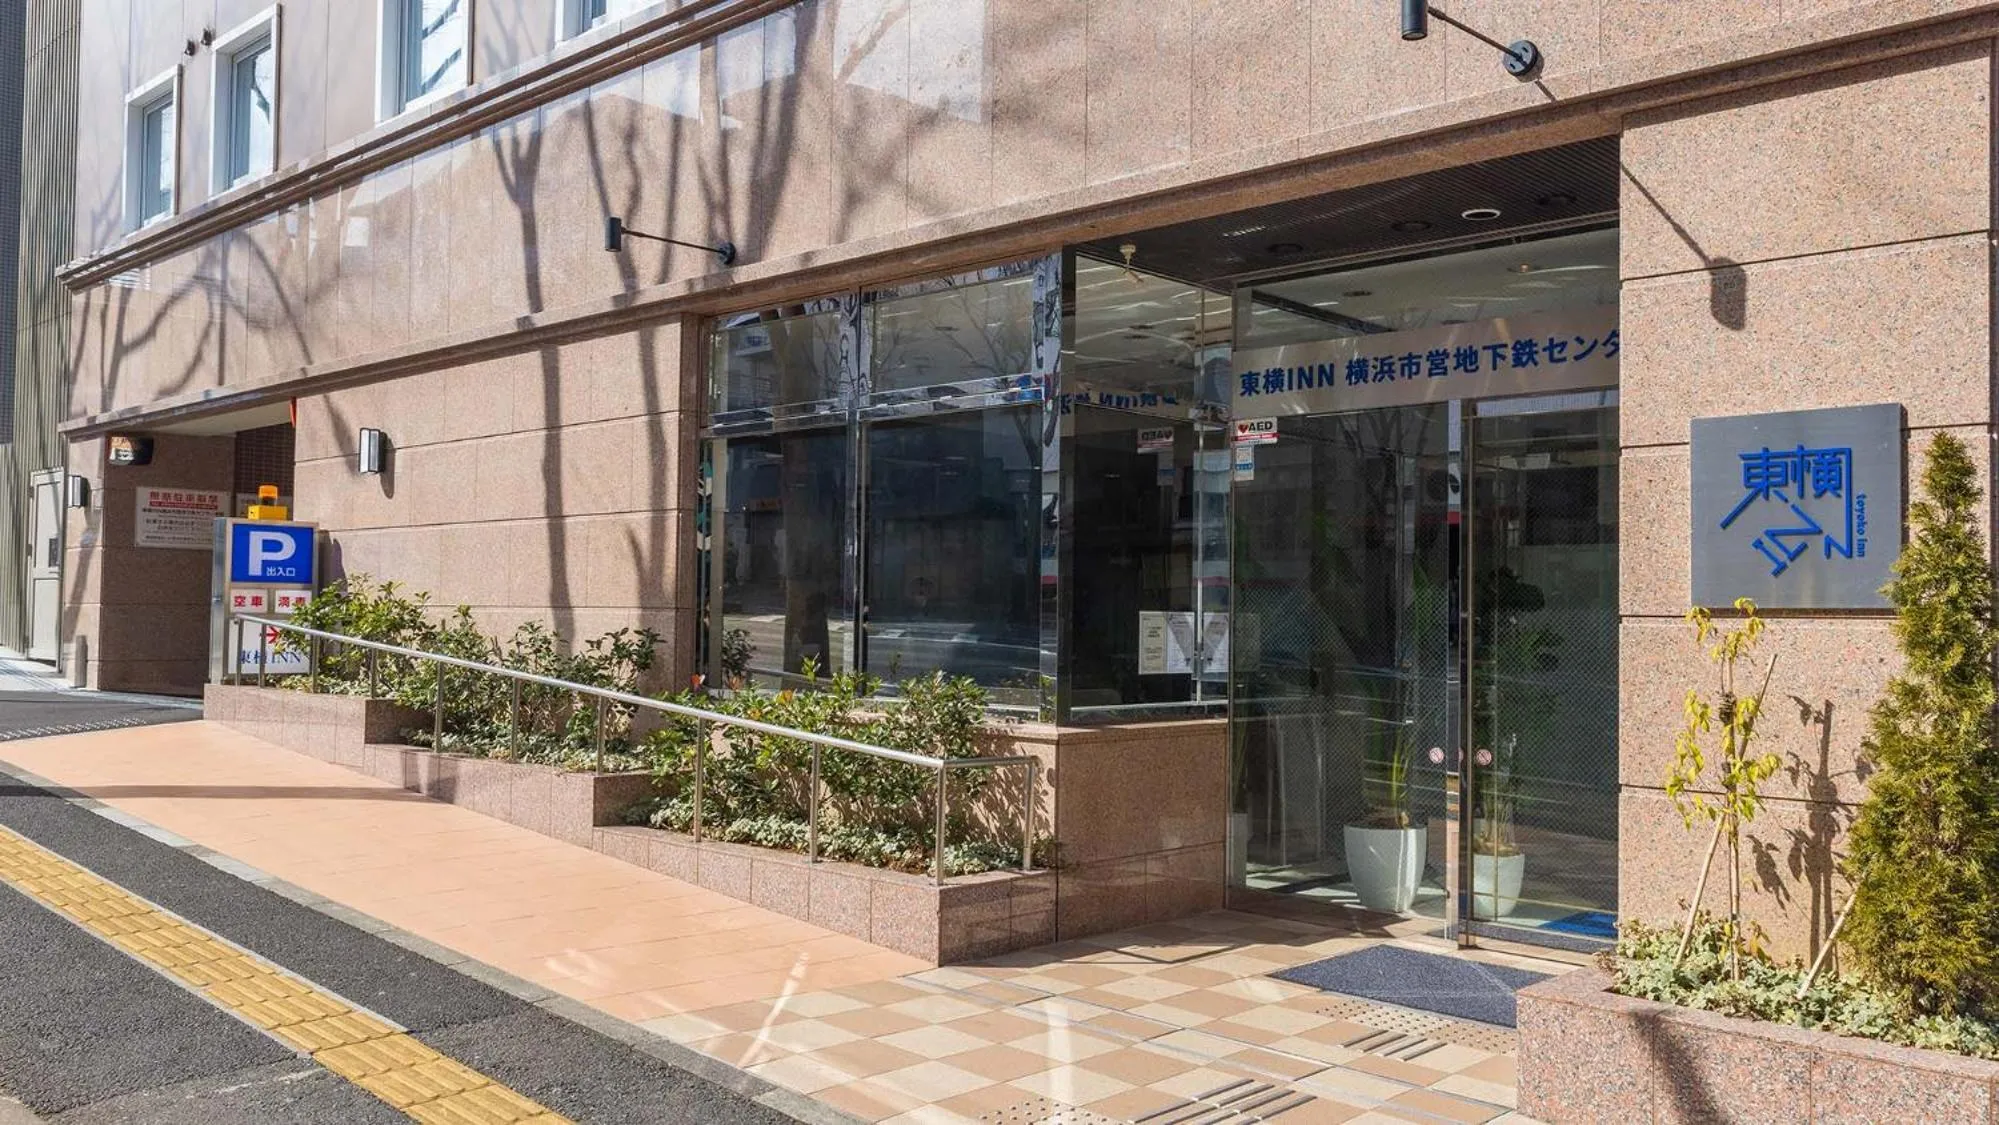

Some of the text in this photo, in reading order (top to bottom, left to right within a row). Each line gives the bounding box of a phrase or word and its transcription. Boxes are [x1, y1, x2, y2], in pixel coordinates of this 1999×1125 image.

[1240, 363, 1335, 397] 東横INN
[1249, 421, 1273, 431] AED
[1855, 493, 1868, 557] toyoko inn
[248, 531, 296, 576] P
[266, 566, 296, 577] 出入口
[234, 595, 263, 607] 空車
